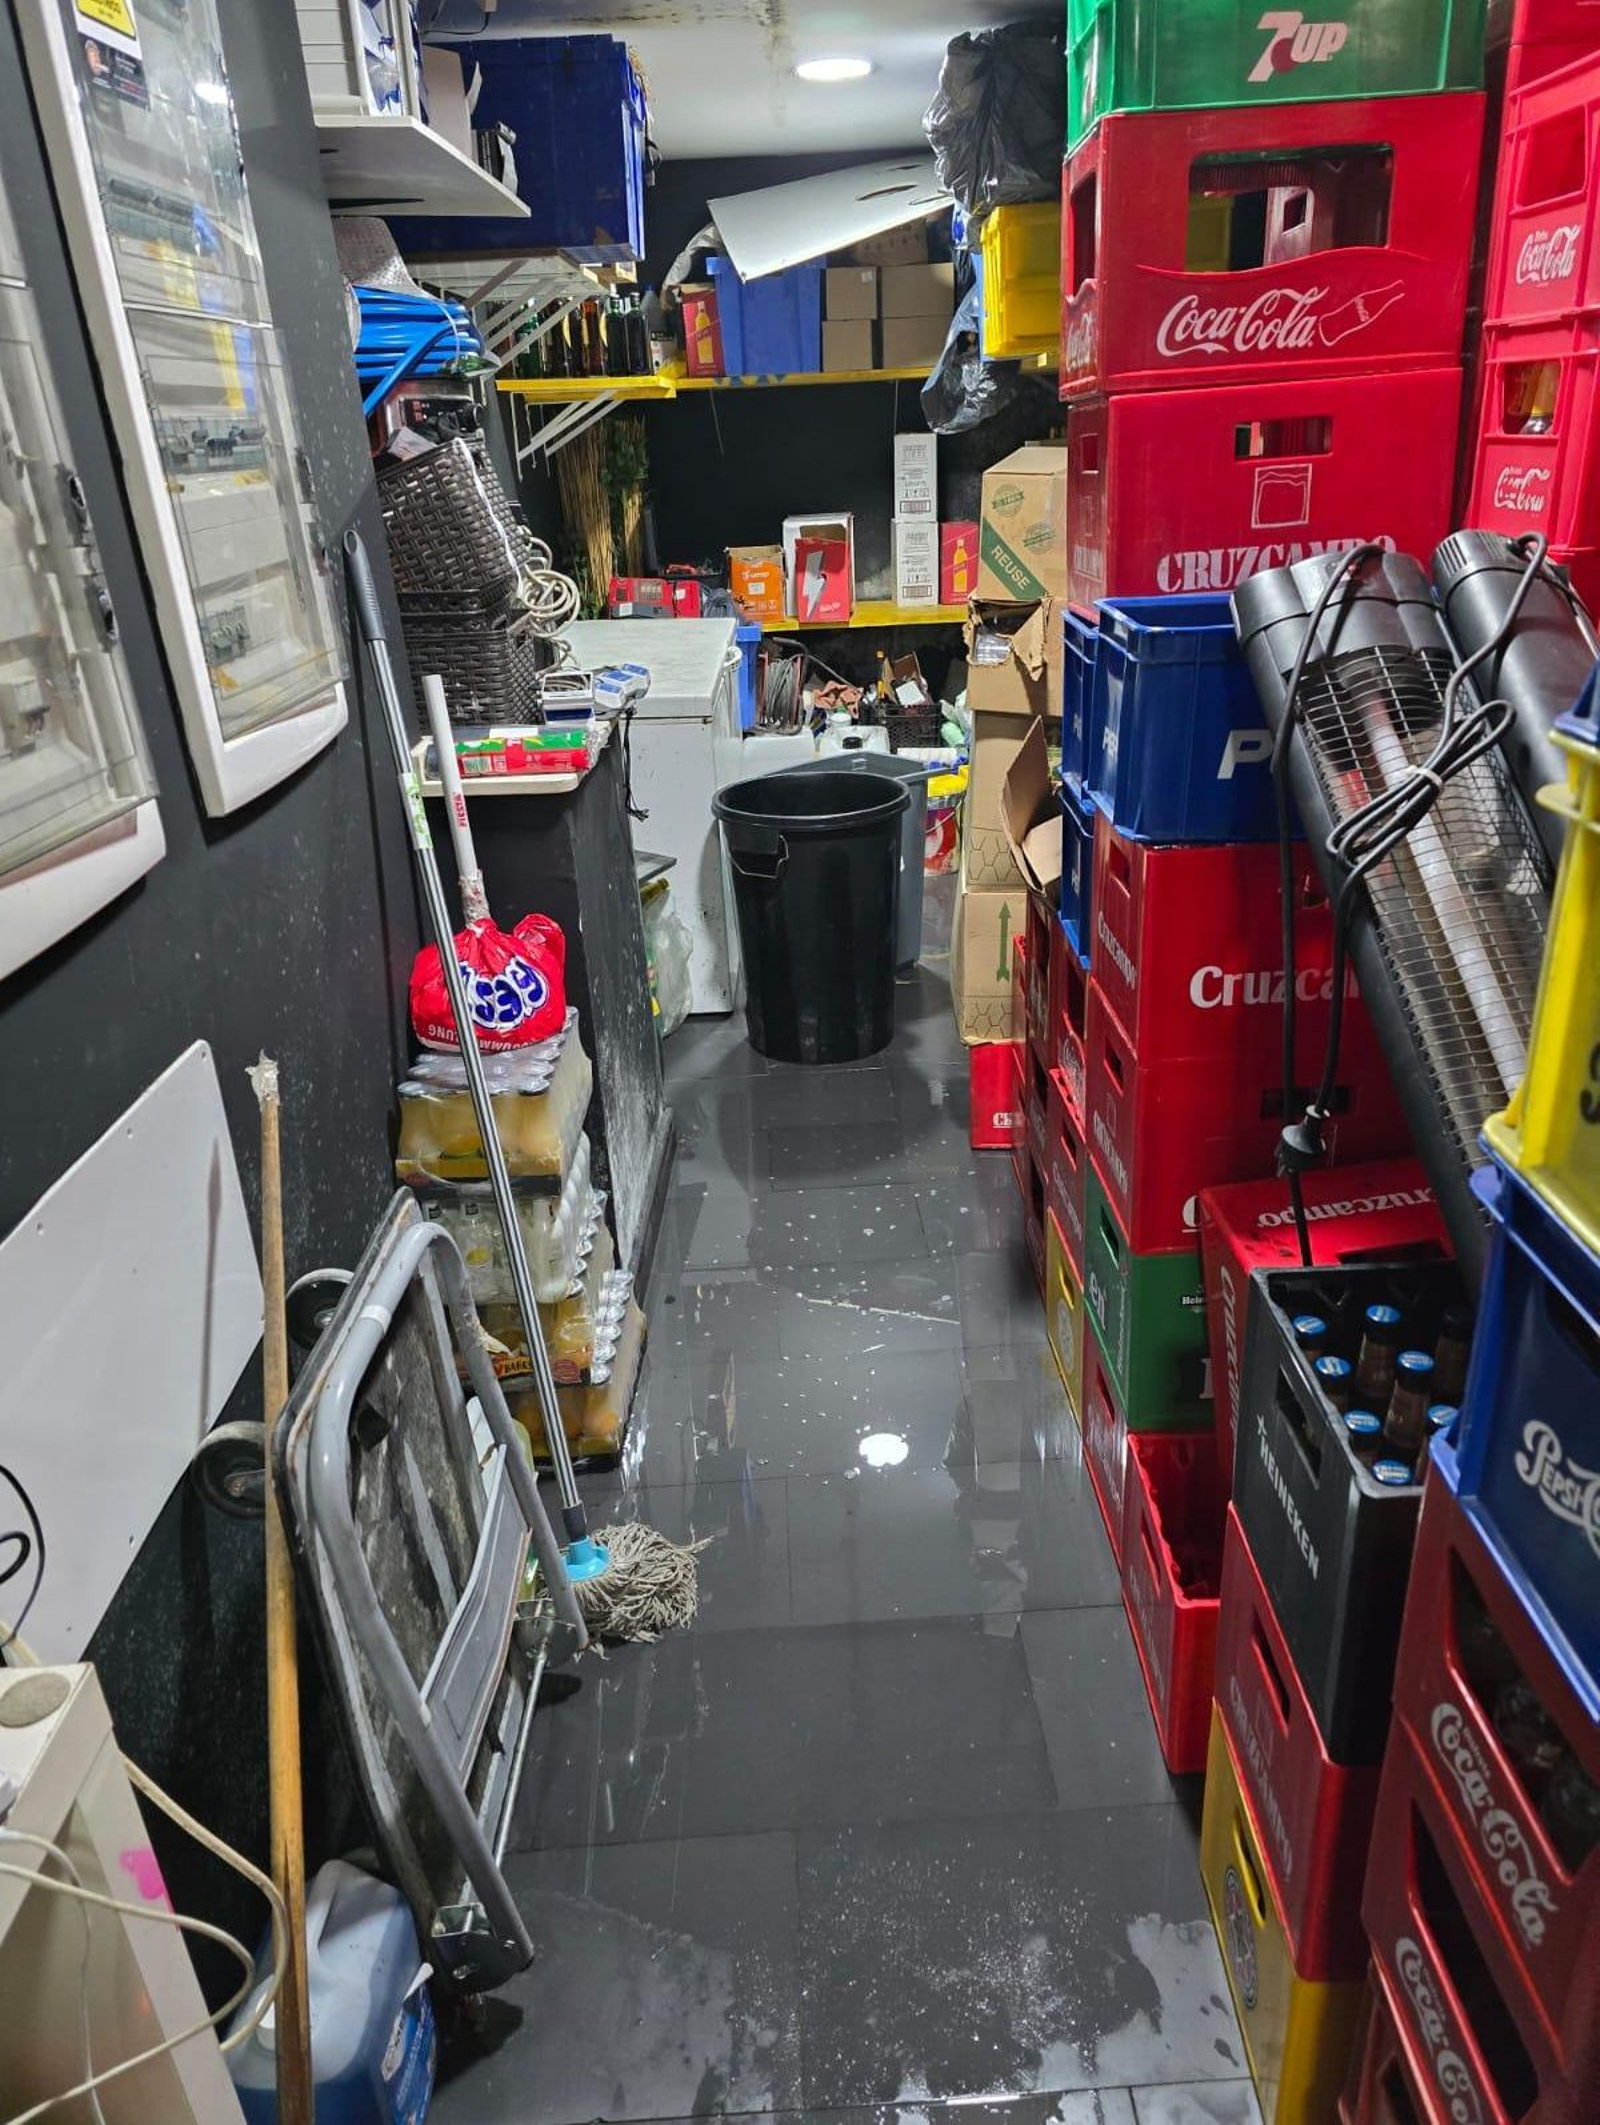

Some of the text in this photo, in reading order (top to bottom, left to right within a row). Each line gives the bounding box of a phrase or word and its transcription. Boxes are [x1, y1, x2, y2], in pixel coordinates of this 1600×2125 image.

[1247, 11, 1348, 82] 7UP
[1156, 286, 1330, 357] Coca-Cola
[991, 544, 1030, 590] REUSE
[1260, 1435, 1319, 1581] HEINEKEN
[1431, 1703, 1557, 1946] Coca-Cola
